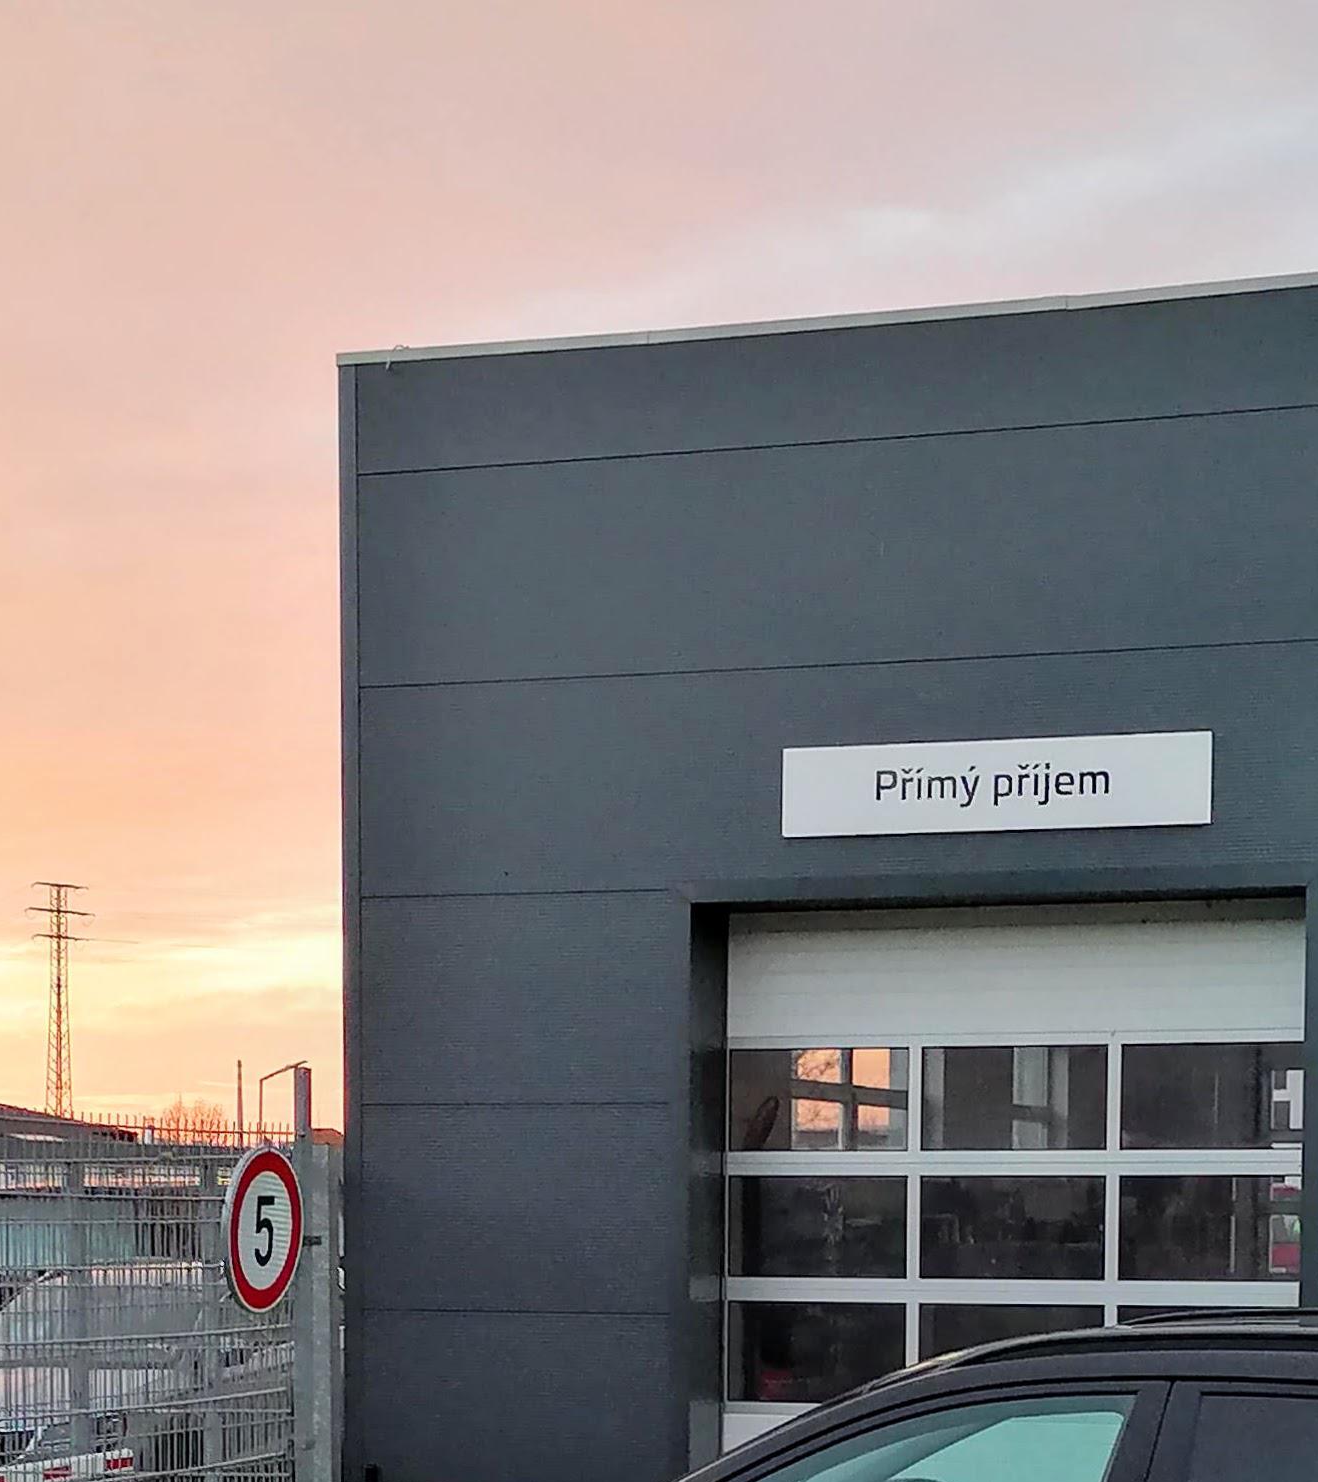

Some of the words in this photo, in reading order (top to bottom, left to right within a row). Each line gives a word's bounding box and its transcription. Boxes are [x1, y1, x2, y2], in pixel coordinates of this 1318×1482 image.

[875, 765, 980, 808] Přímý
[993, 762, 1110, 807] příjem
[254, 1195, 275, 1268] 5
